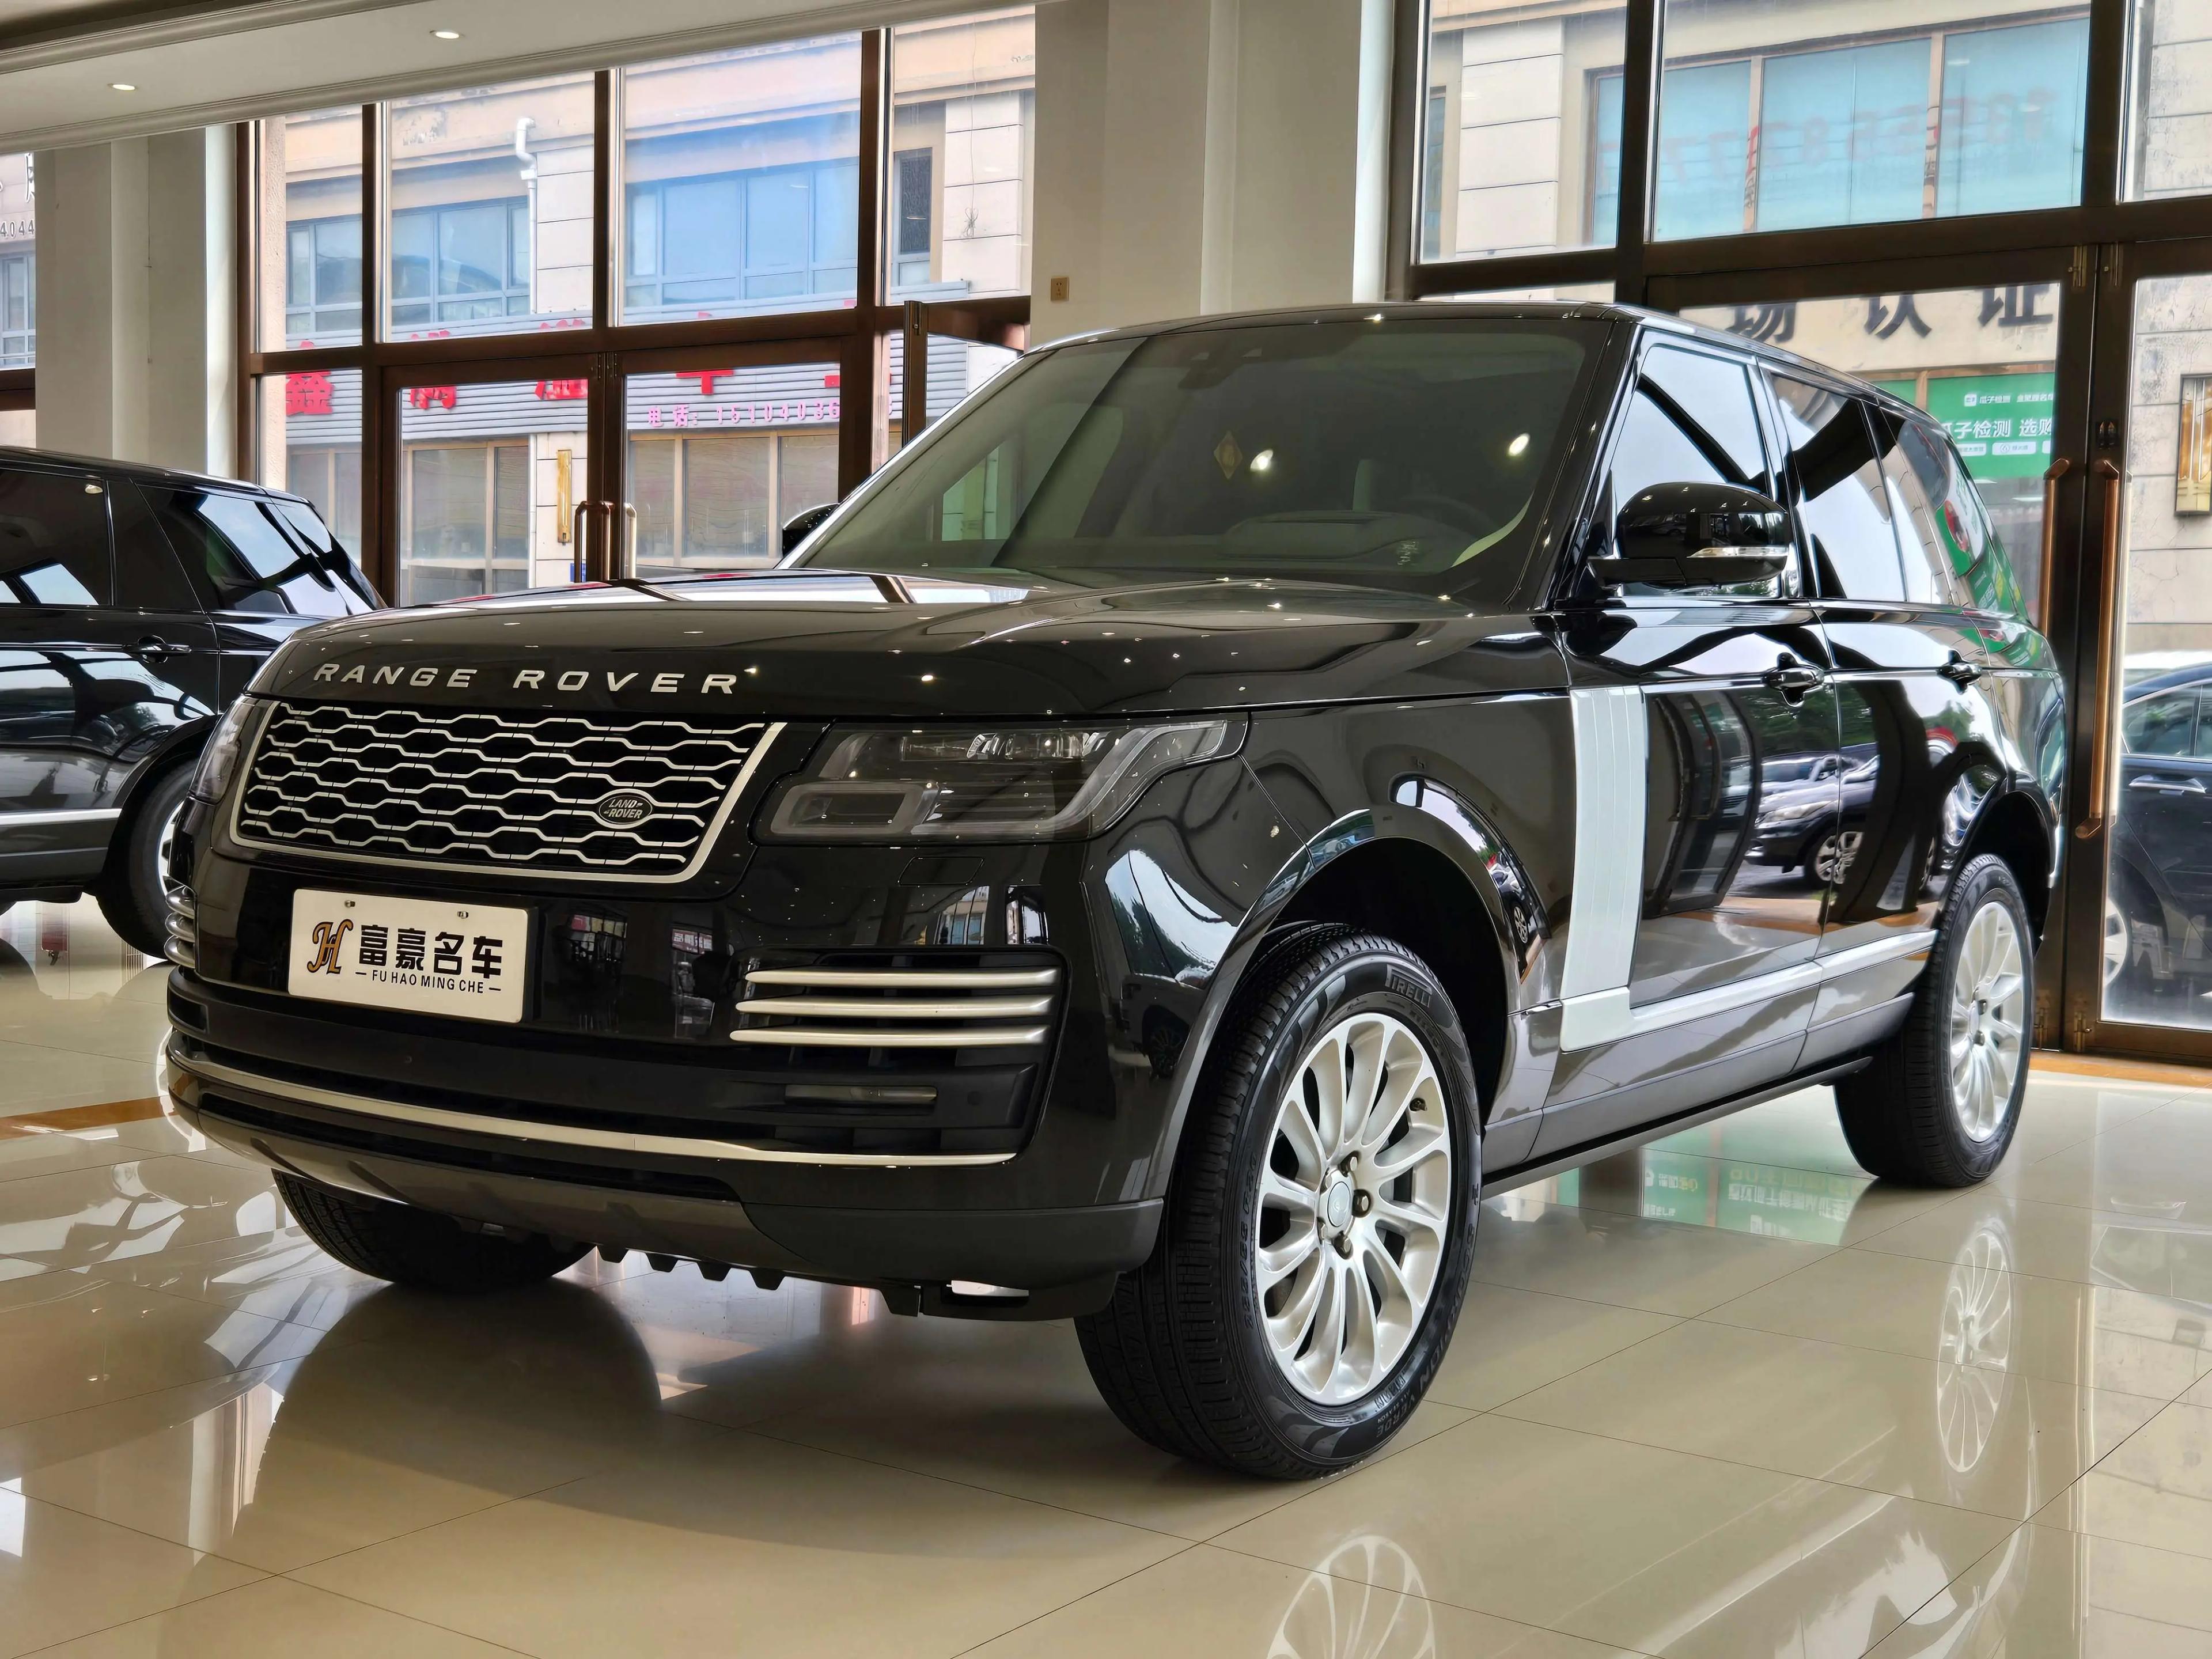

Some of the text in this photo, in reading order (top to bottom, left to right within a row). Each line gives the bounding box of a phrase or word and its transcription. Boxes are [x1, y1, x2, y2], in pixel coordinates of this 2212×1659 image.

[314, 663, 737, 694] RANGE ROVER
[608, 798, 638, 808] LAND
[608, 808, 643, 819] ROVER
[358, 924, 503, 979] 富豪名车
[372, 970, 484, 994] FU HAO MING CHE
[1384, 964, 1433, 1008] PIRELLI
